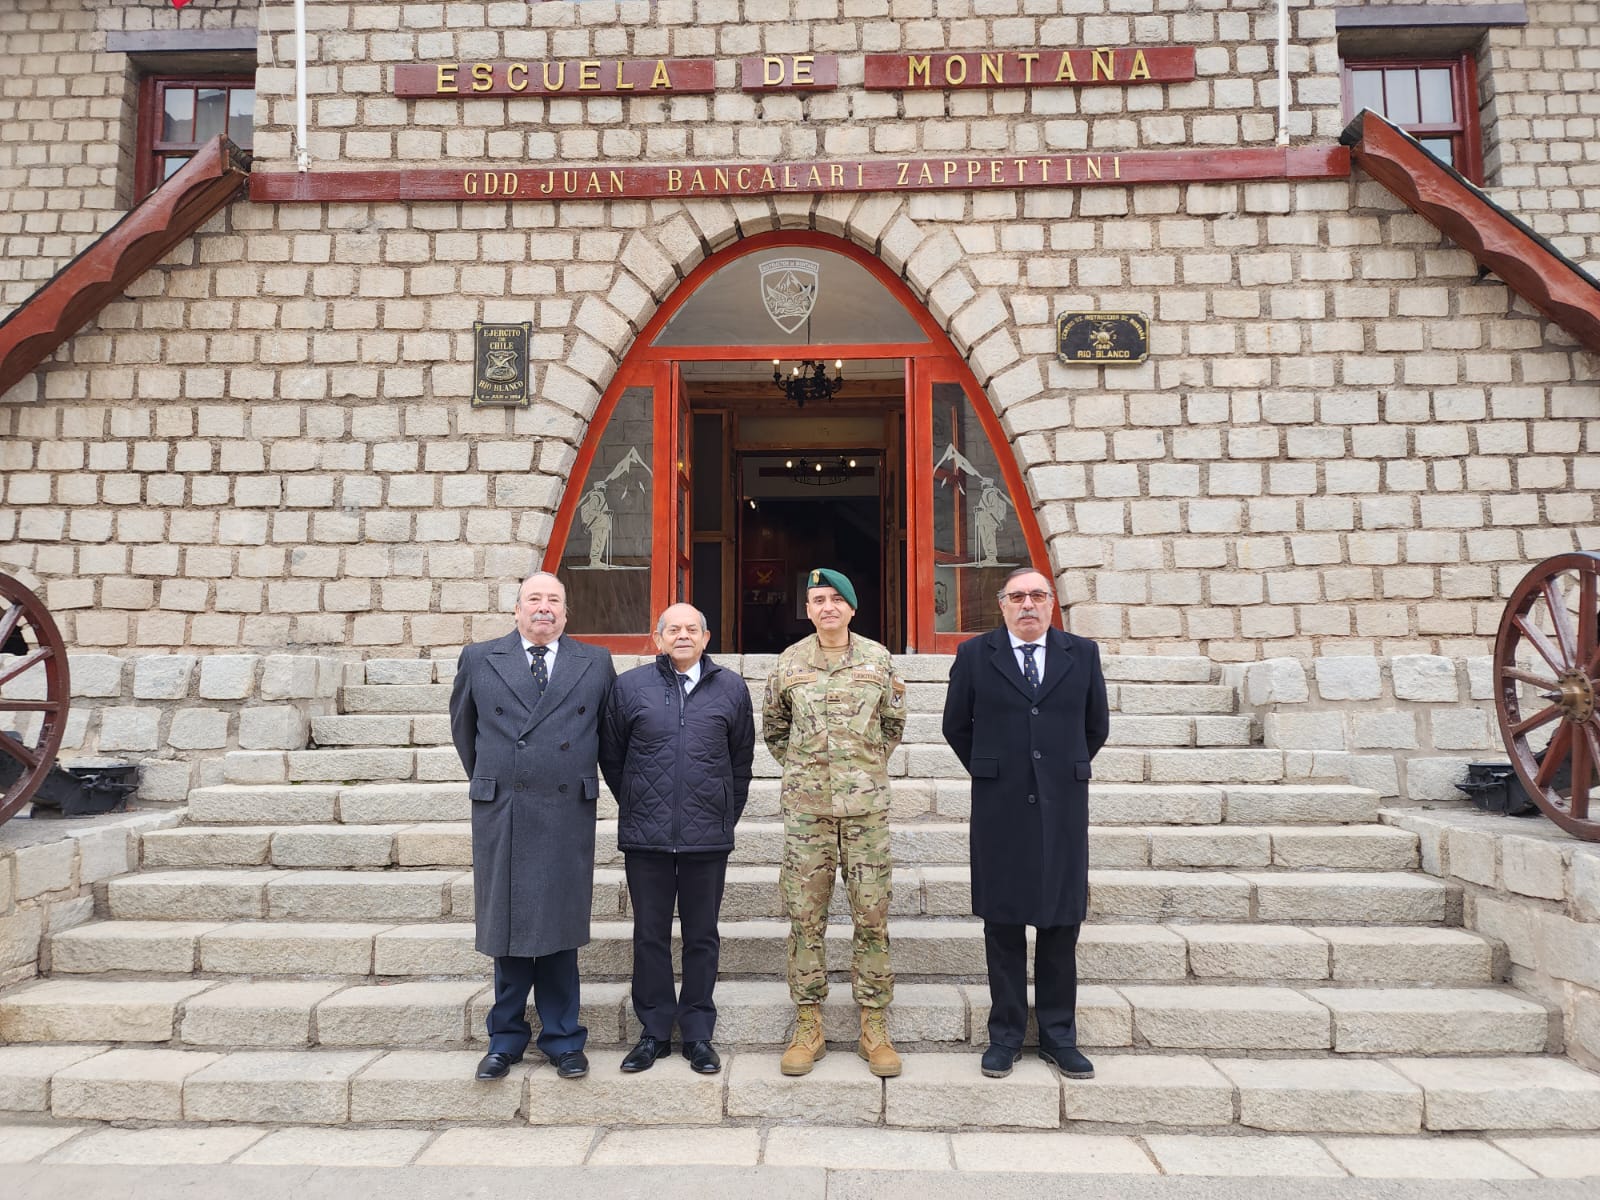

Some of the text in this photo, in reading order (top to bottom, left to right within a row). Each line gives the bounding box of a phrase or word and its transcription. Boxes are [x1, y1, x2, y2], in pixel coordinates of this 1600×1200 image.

[436, 46, 1152, 93] ESCUELA DE MONTAÑA
[464, 156, 1121, 195] GDD. JUAN BANCALARI ZAPPETTINI
[484, 329, 521, 337] EJERCITO
[489, 342, 514, 350] CHILE
[493, 381, 524, 392] BLANCO
